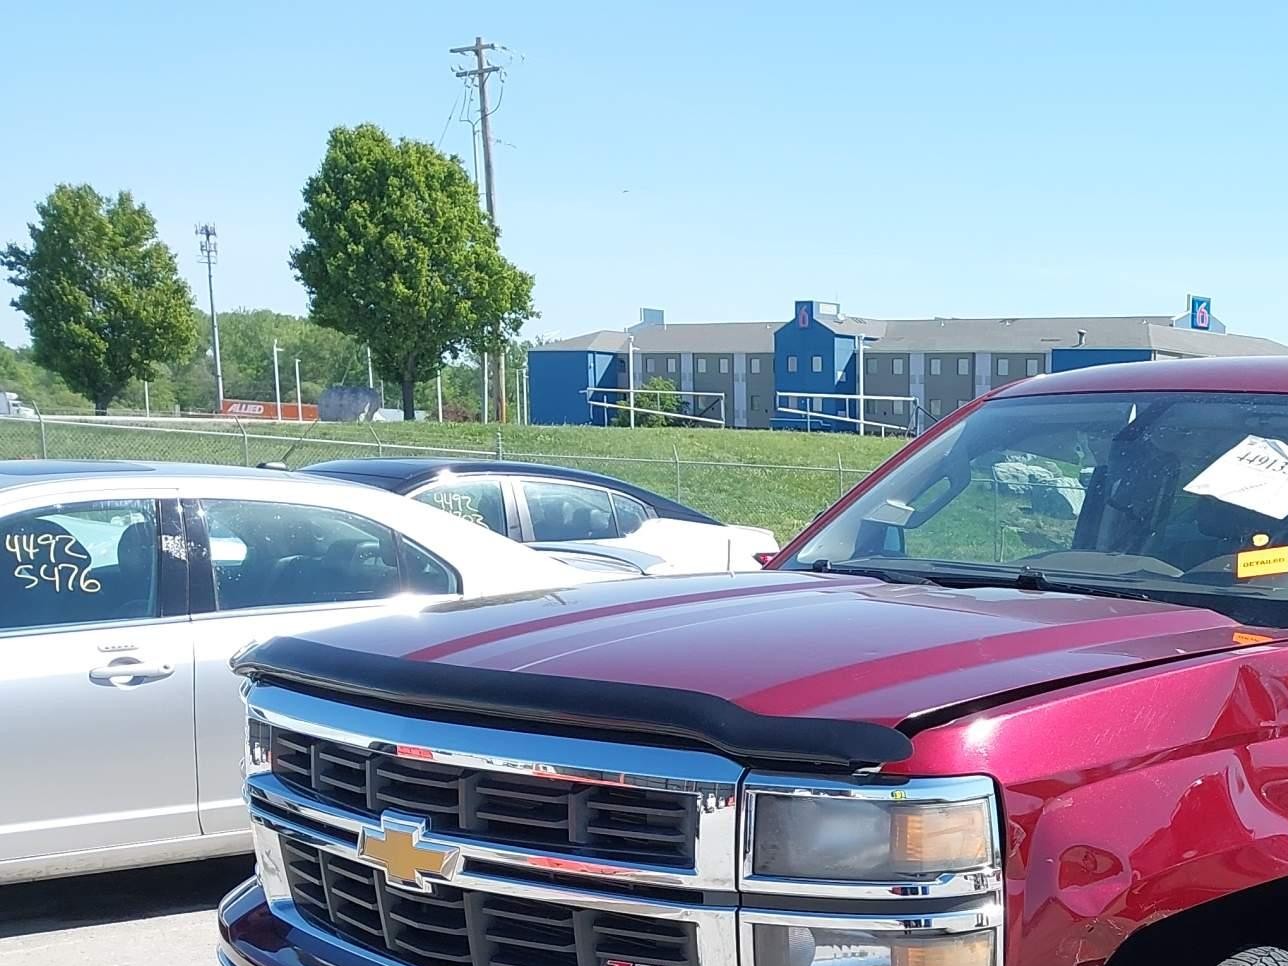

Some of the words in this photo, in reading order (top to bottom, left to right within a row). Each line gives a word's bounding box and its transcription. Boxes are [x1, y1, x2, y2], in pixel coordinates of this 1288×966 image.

[798, 304, 809, 329] 6
[1196, 302, 1209, 328] 6
[227, 403, 264, 415] ALLIED
[433, 492, 479, 512] 4492
[5, 534, 87, 563] 4492
[14, 563, 101, 592] 5476
